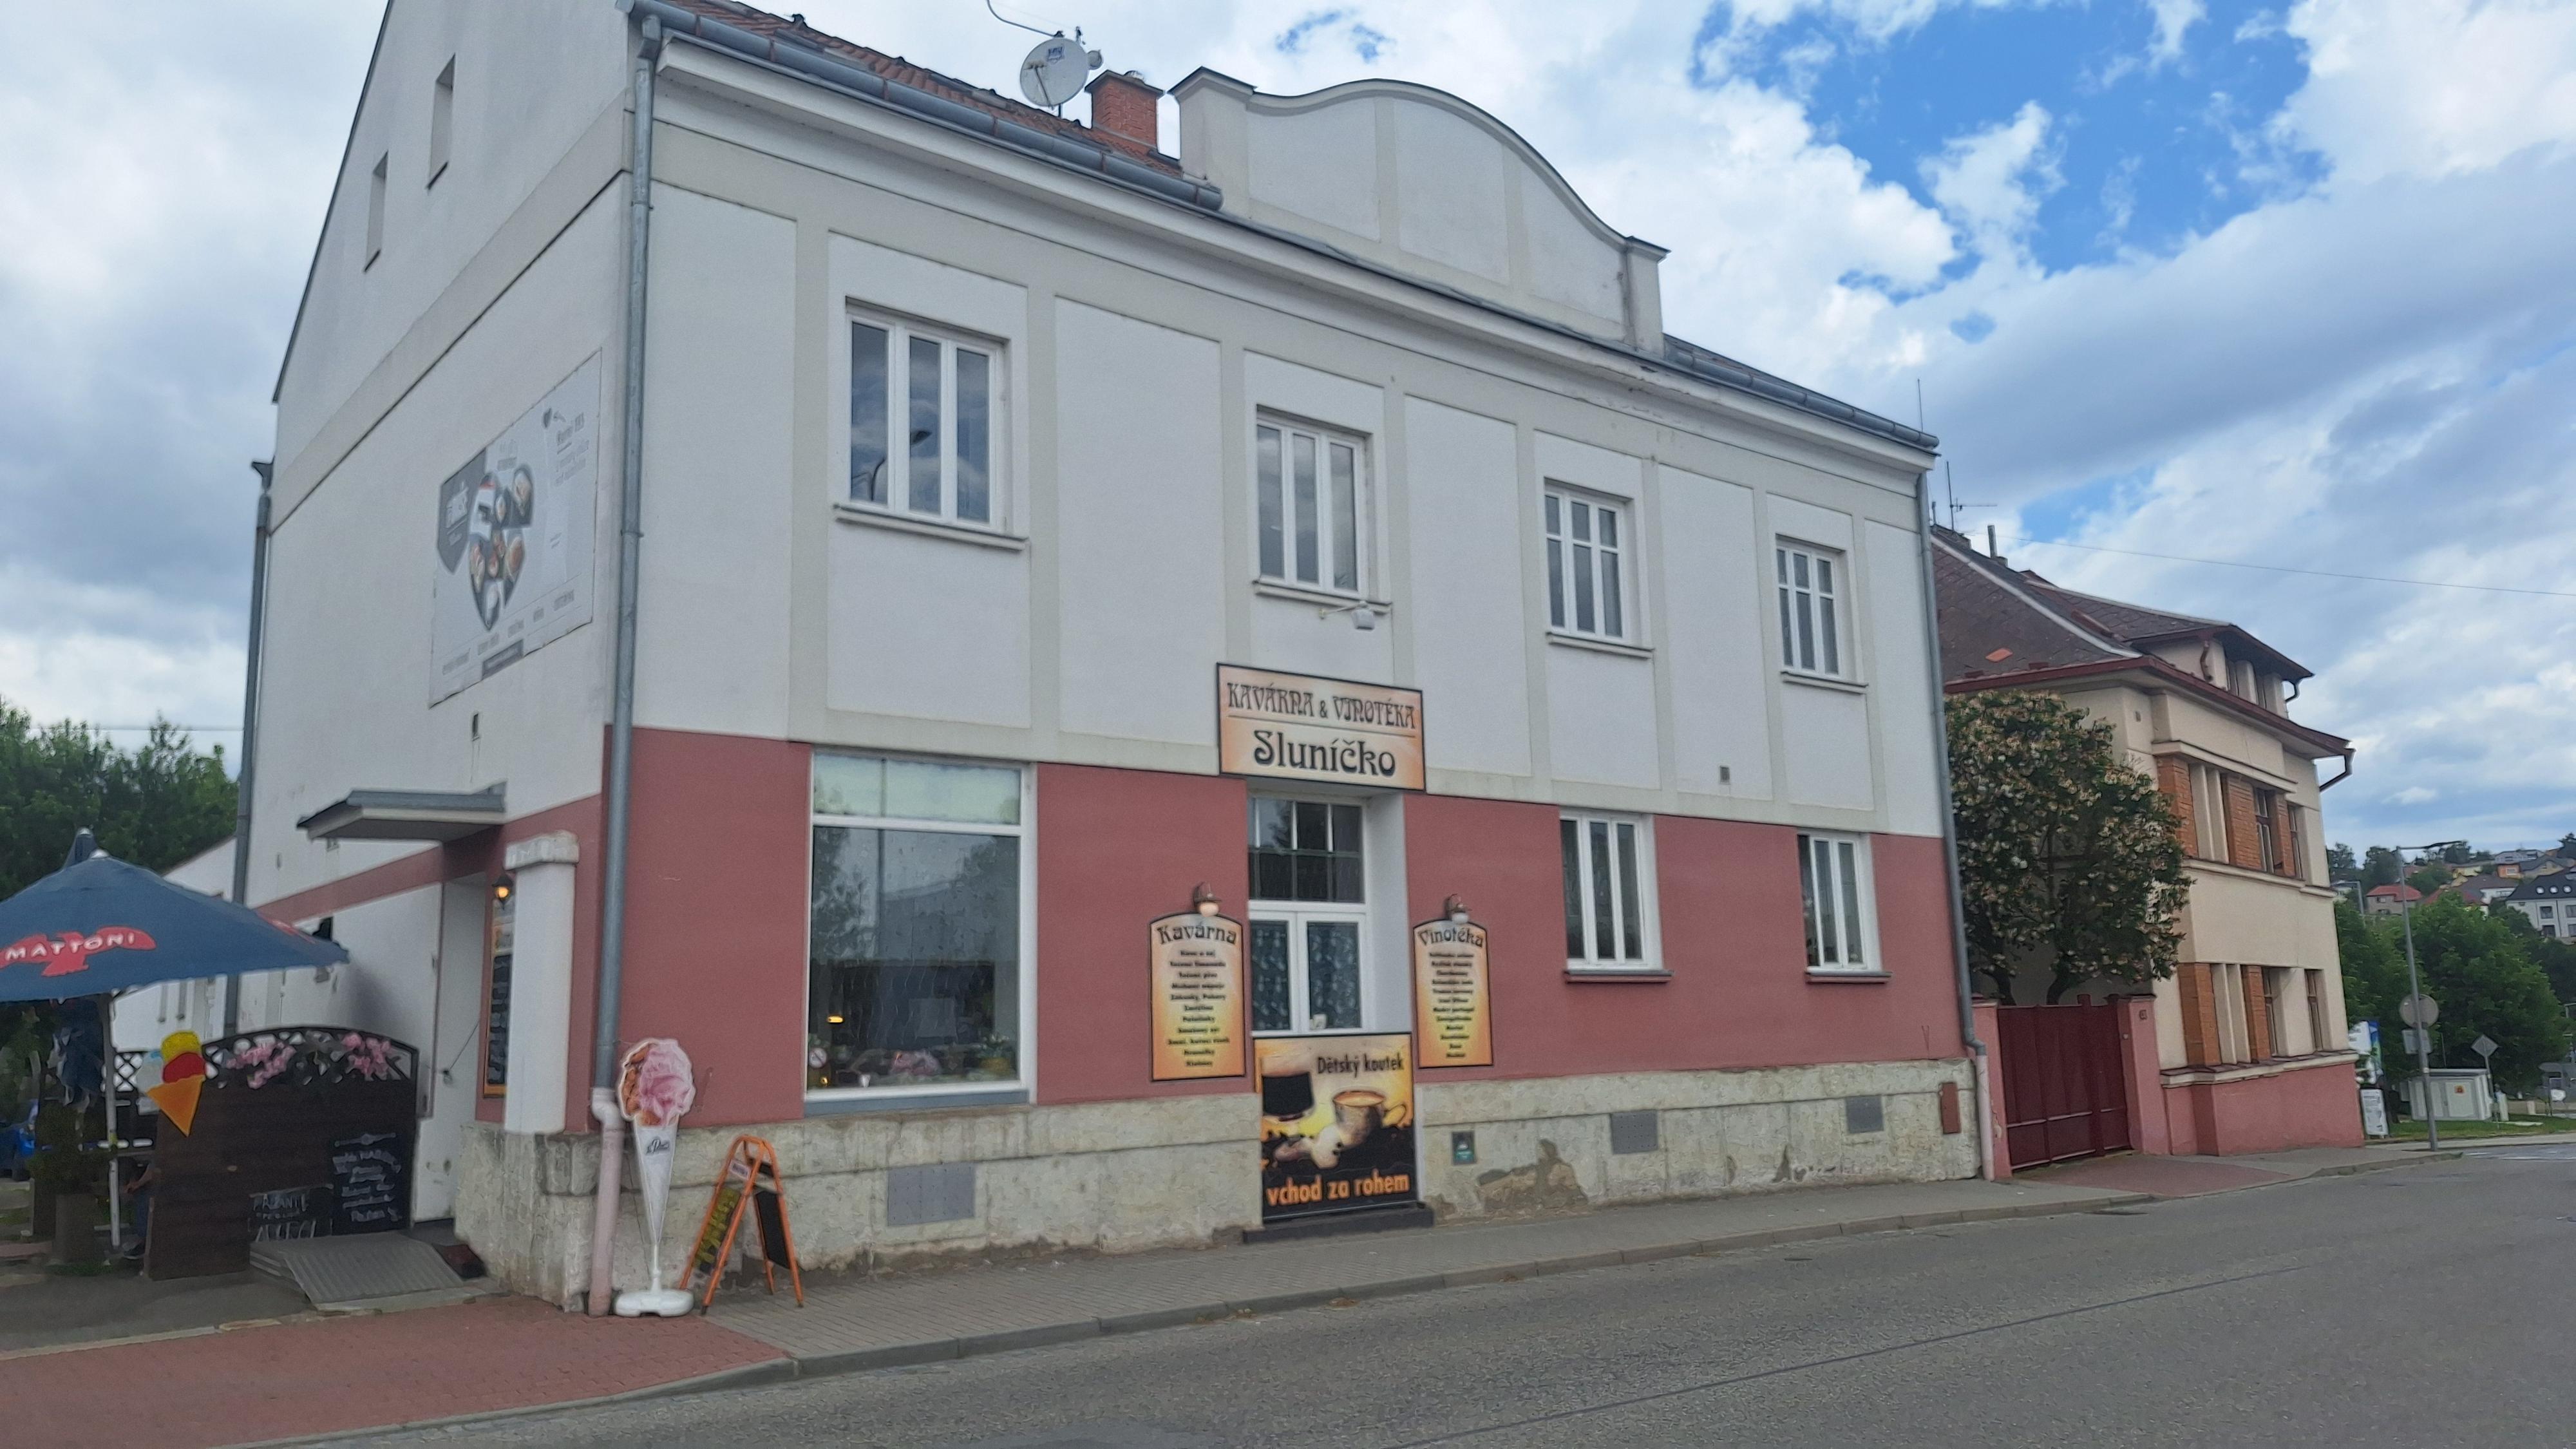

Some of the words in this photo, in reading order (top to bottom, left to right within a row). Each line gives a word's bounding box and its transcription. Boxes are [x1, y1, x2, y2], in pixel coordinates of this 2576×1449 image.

[1227, 683, 1314, 717] KAVÁRNA
[1320, 700, 1329, 718] &
[1332, 696, 1416, 729] VINOTÉKA
[1254, 730, 1396, 777] Sluníčko
[5, 932, 135, 961] MATTONI
[1157, 921, 1236, 945] Kavárna
[1419, 926, 1483, 948] Vinotéka
[1318, 1054, 1360, 1077] Dětský
[1364, 1052, 1404, 1074] koutek
[1267, 1174, 1323, 1206] vchod
[1356, 1168, 1410, 1196] rohem
